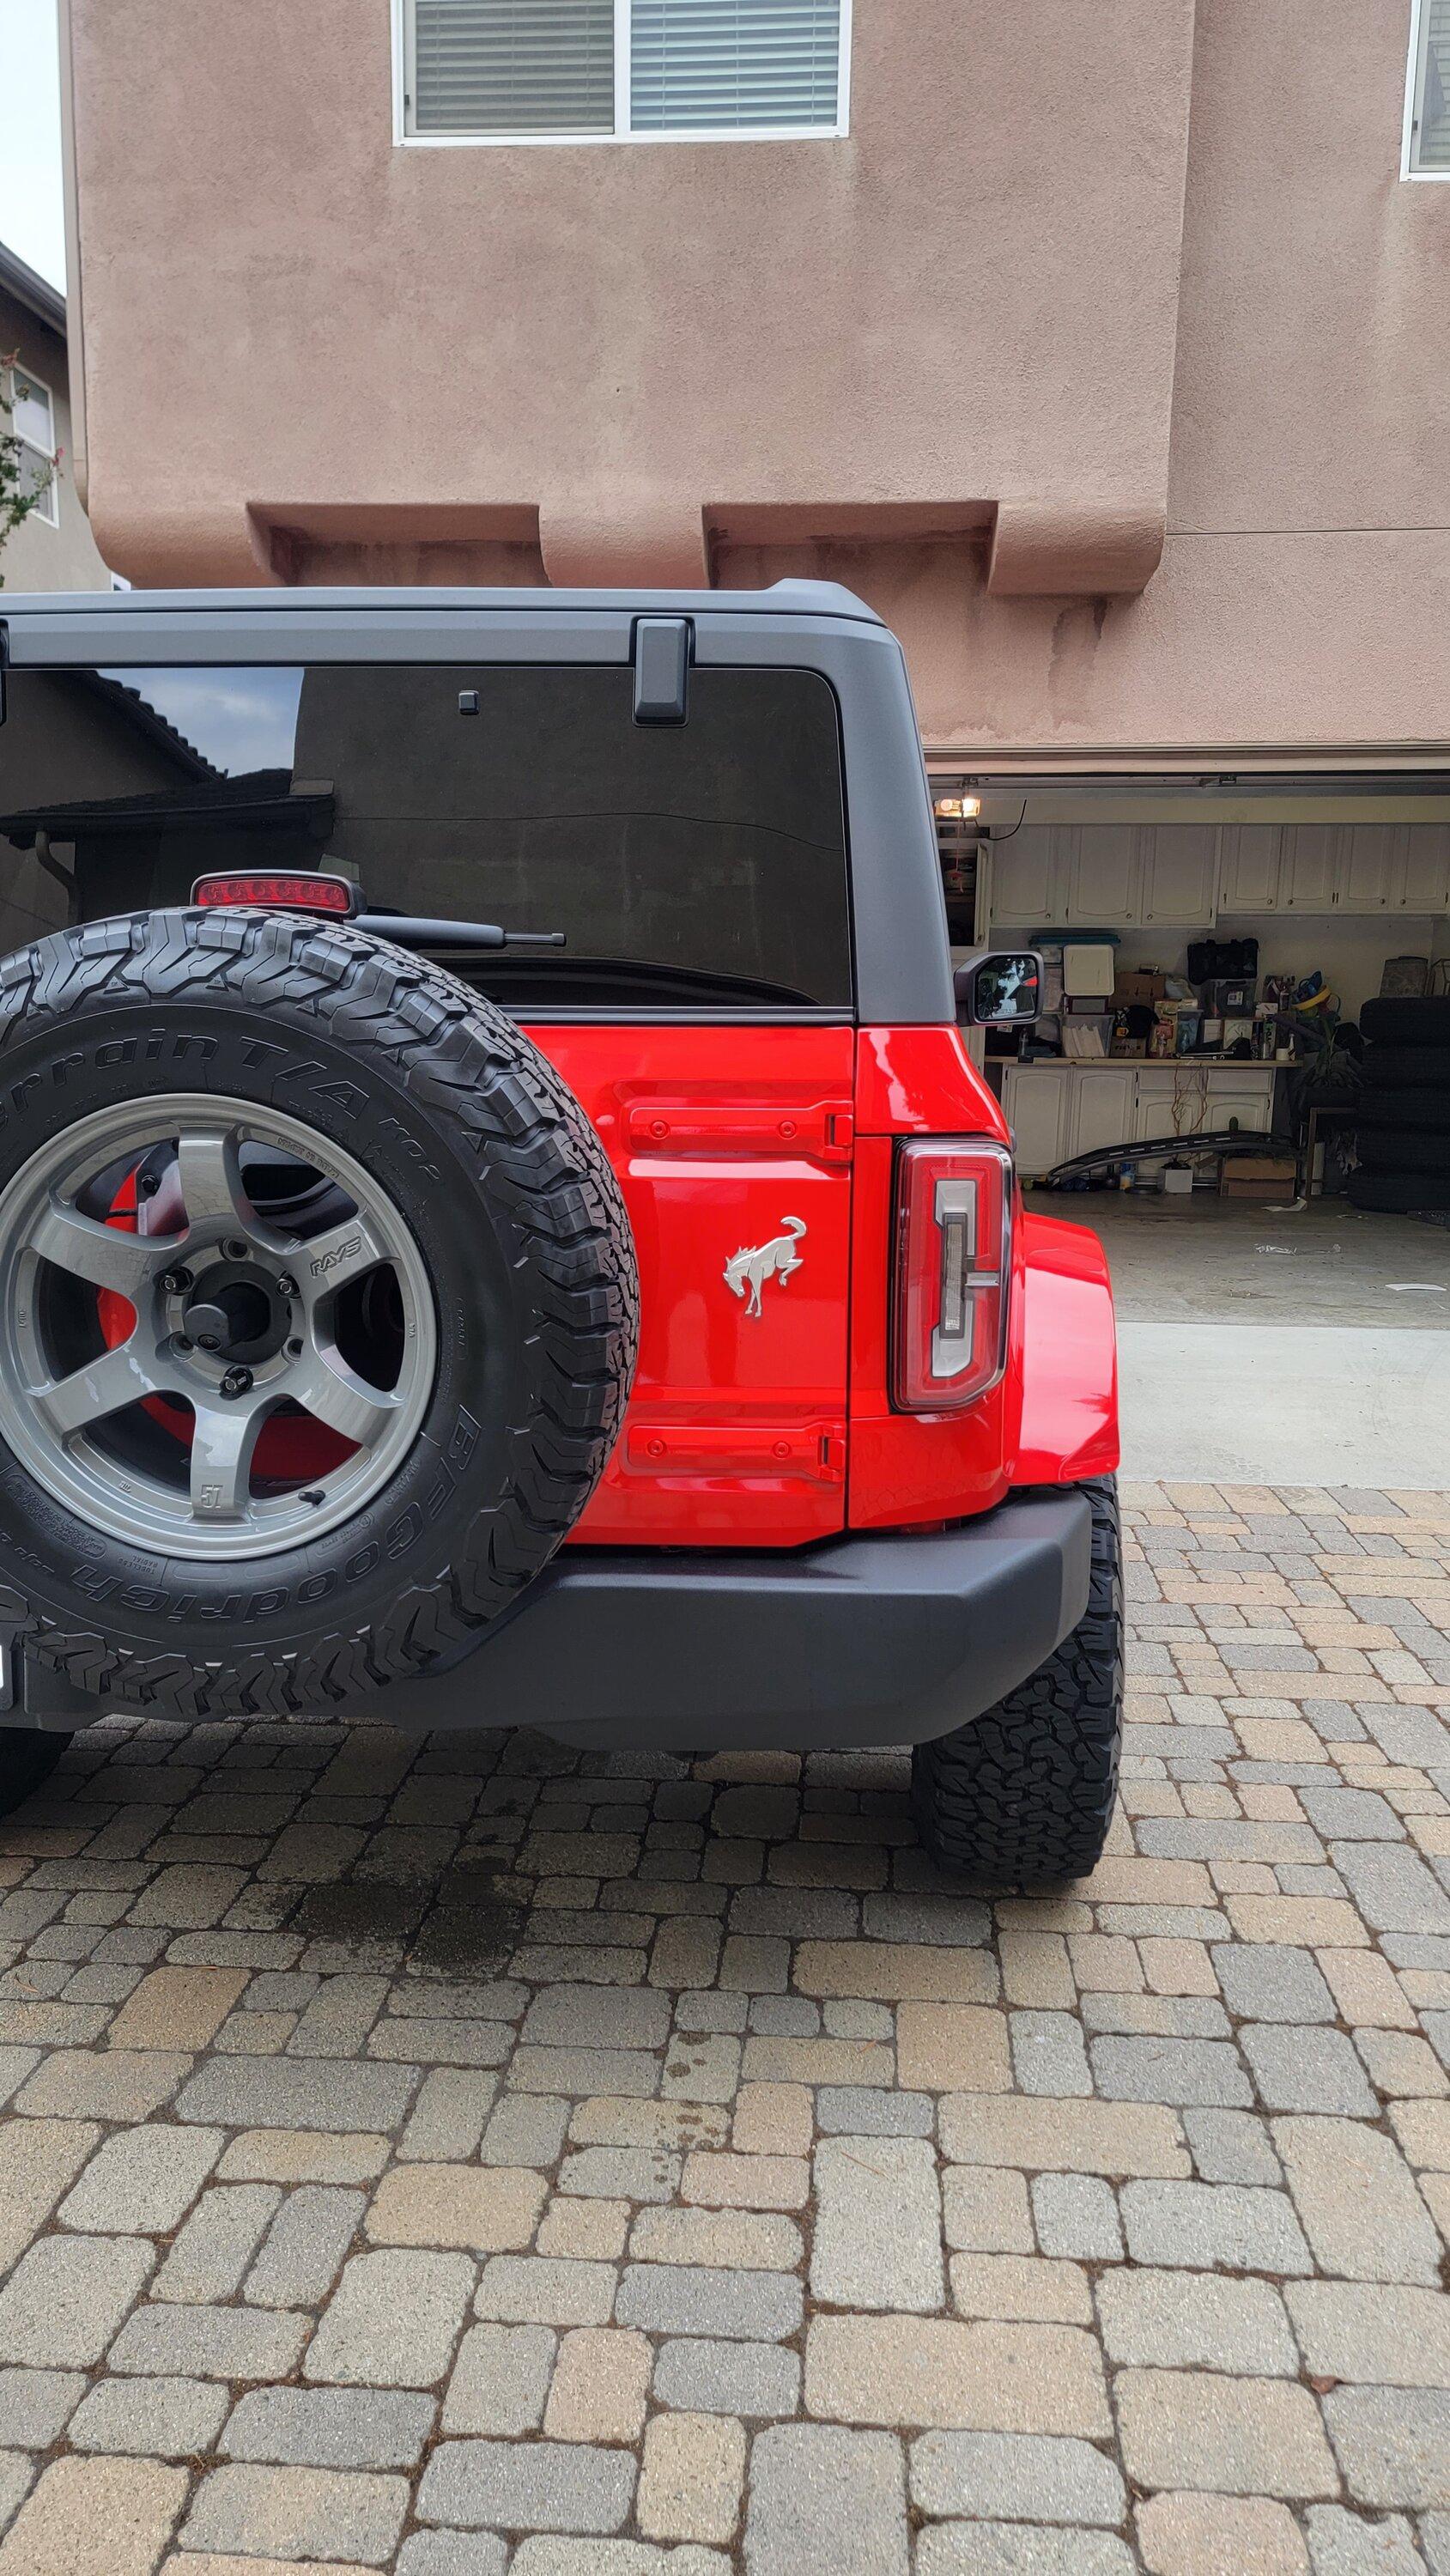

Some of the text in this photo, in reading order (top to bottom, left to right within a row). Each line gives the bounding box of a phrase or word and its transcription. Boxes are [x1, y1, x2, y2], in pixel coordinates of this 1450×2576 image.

[0, 1028, 219, 1128] rrain
[309, 1236, 361, 1278] RAYS
[69, 1403, 483, 1625] BFGoodrich
